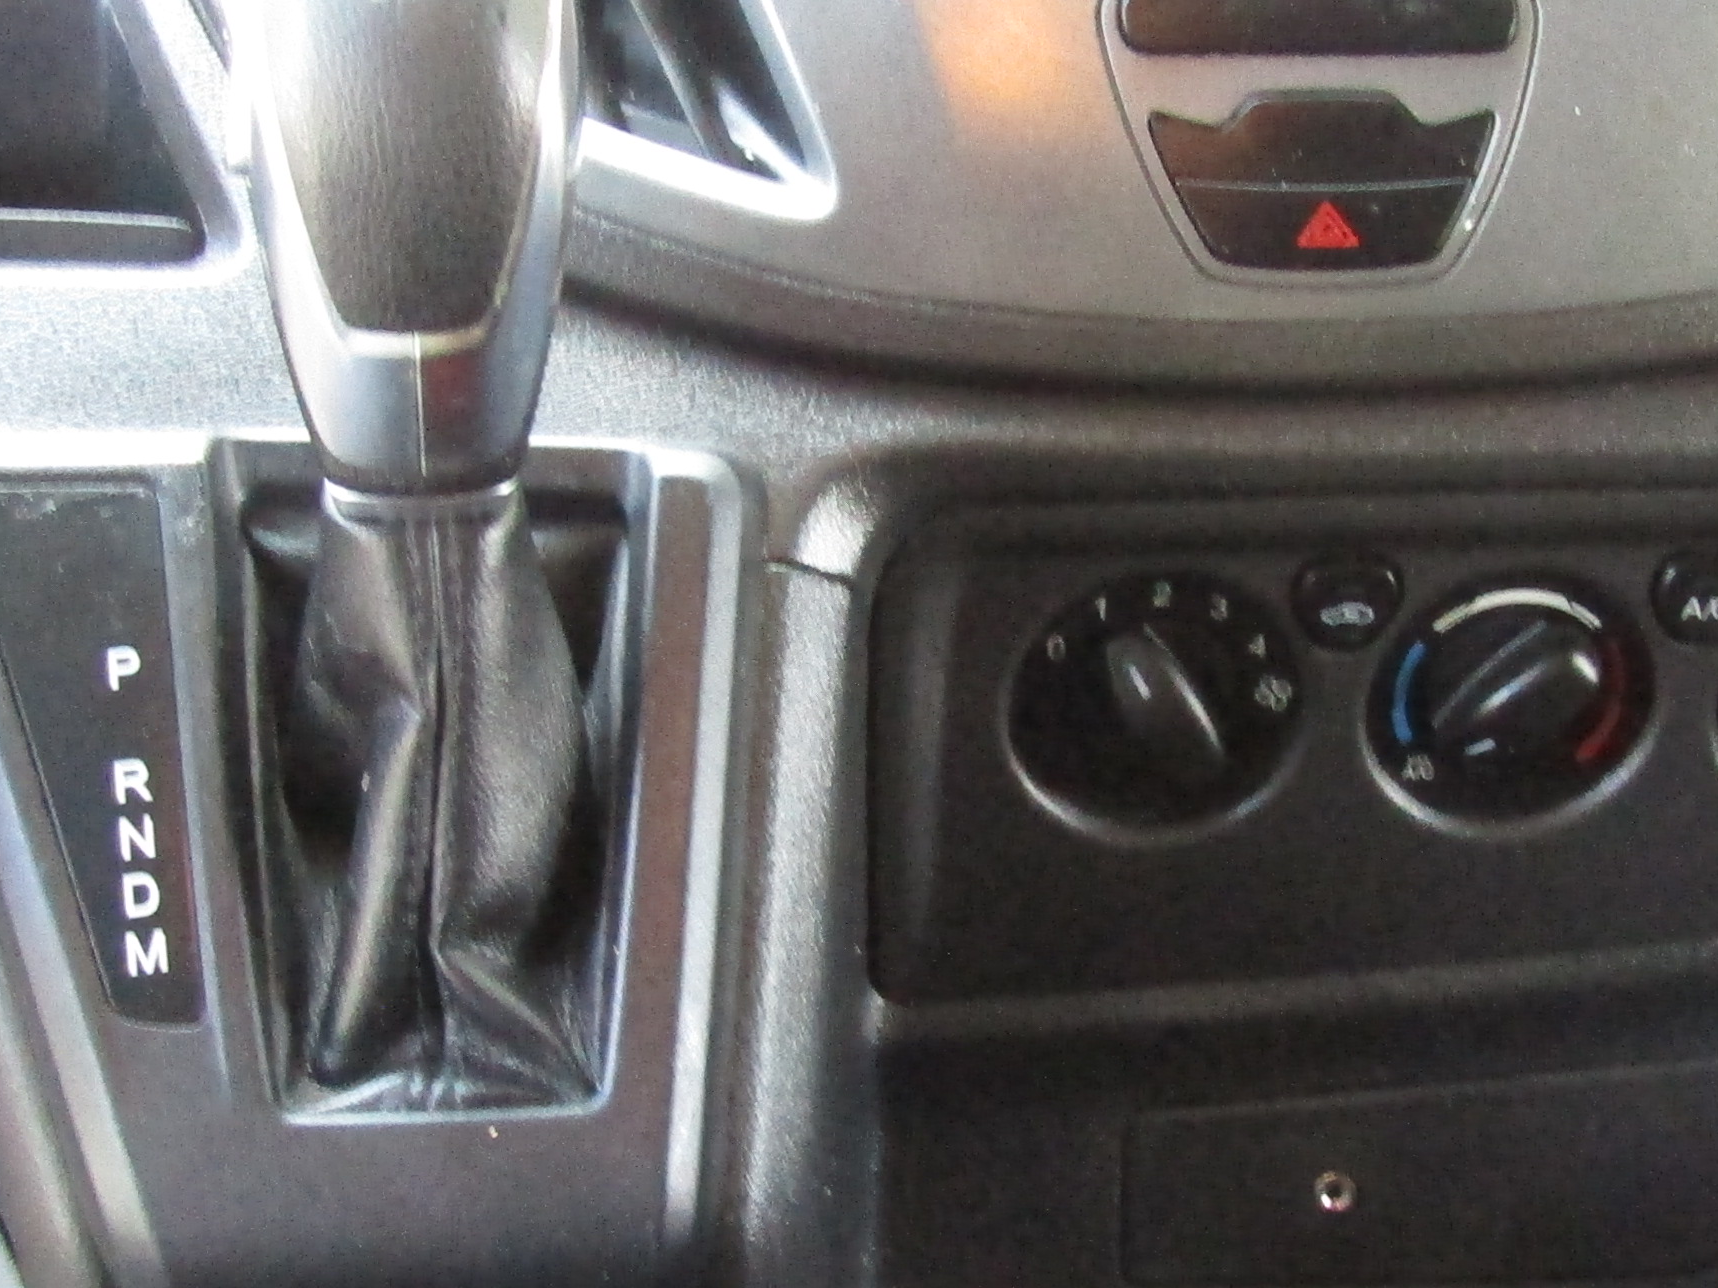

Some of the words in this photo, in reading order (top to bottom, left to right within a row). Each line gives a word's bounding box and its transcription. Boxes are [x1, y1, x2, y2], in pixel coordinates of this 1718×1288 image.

[106, 645, 141, 691] P
[113, 758, 153, 805] R
[118, 814, 156, 862] N
[122, 871, 160, 919] D
[125, 927, 169, 977] M
